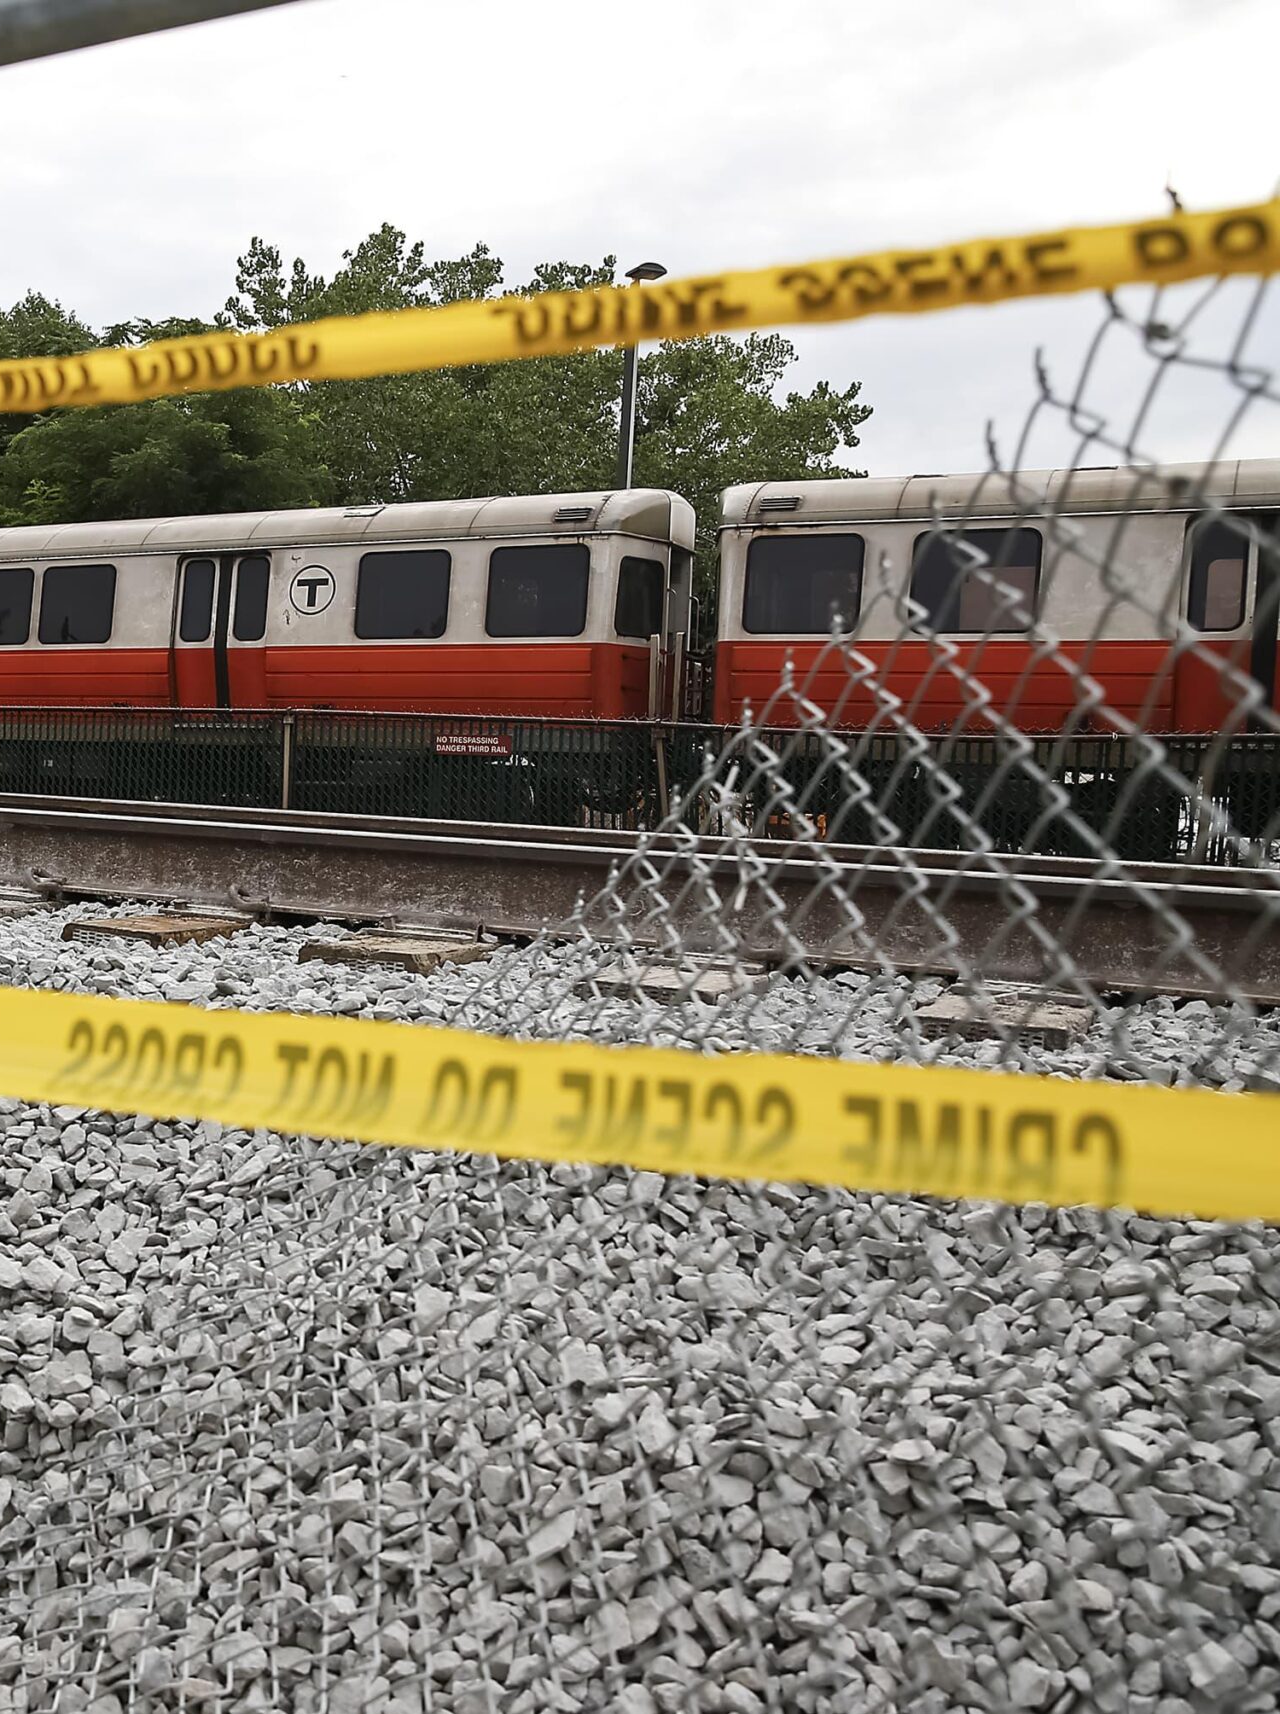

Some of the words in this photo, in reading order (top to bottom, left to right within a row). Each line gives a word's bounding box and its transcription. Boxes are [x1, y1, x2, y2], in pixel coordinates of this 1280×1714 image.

[436, 736, 448, 744] NO
[449, 736, 499, 745] TRESPASSING
[436, 744, 466, 753] DANGER
[467, 745, 489, 753] THIRD
